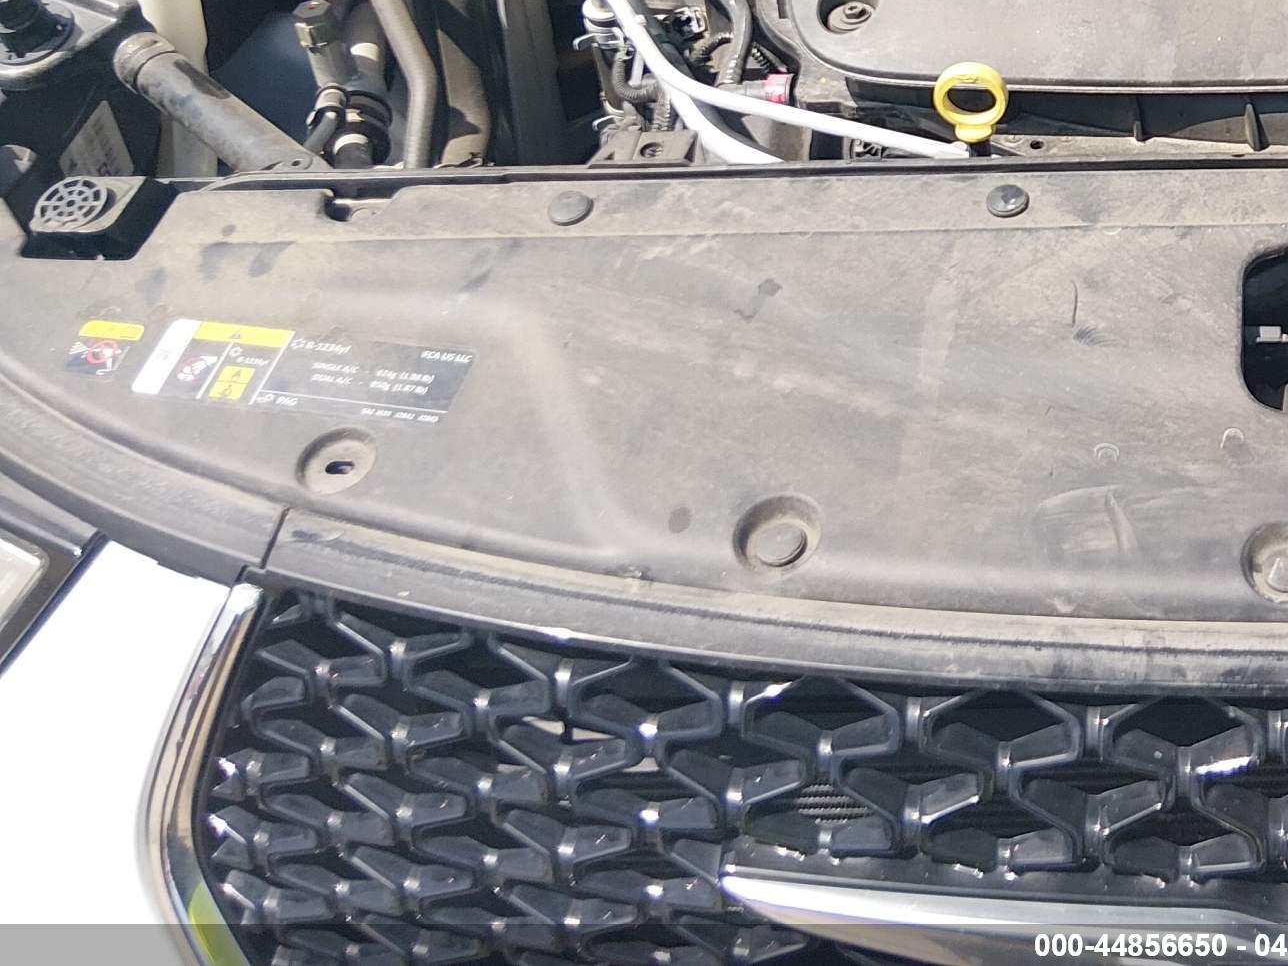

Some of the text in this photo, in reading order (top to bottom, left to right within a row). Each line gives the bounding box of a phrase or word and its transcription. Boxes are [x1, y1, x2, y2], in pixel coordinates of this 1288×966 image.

[420, 350, 473, 363] FCA US LLC
